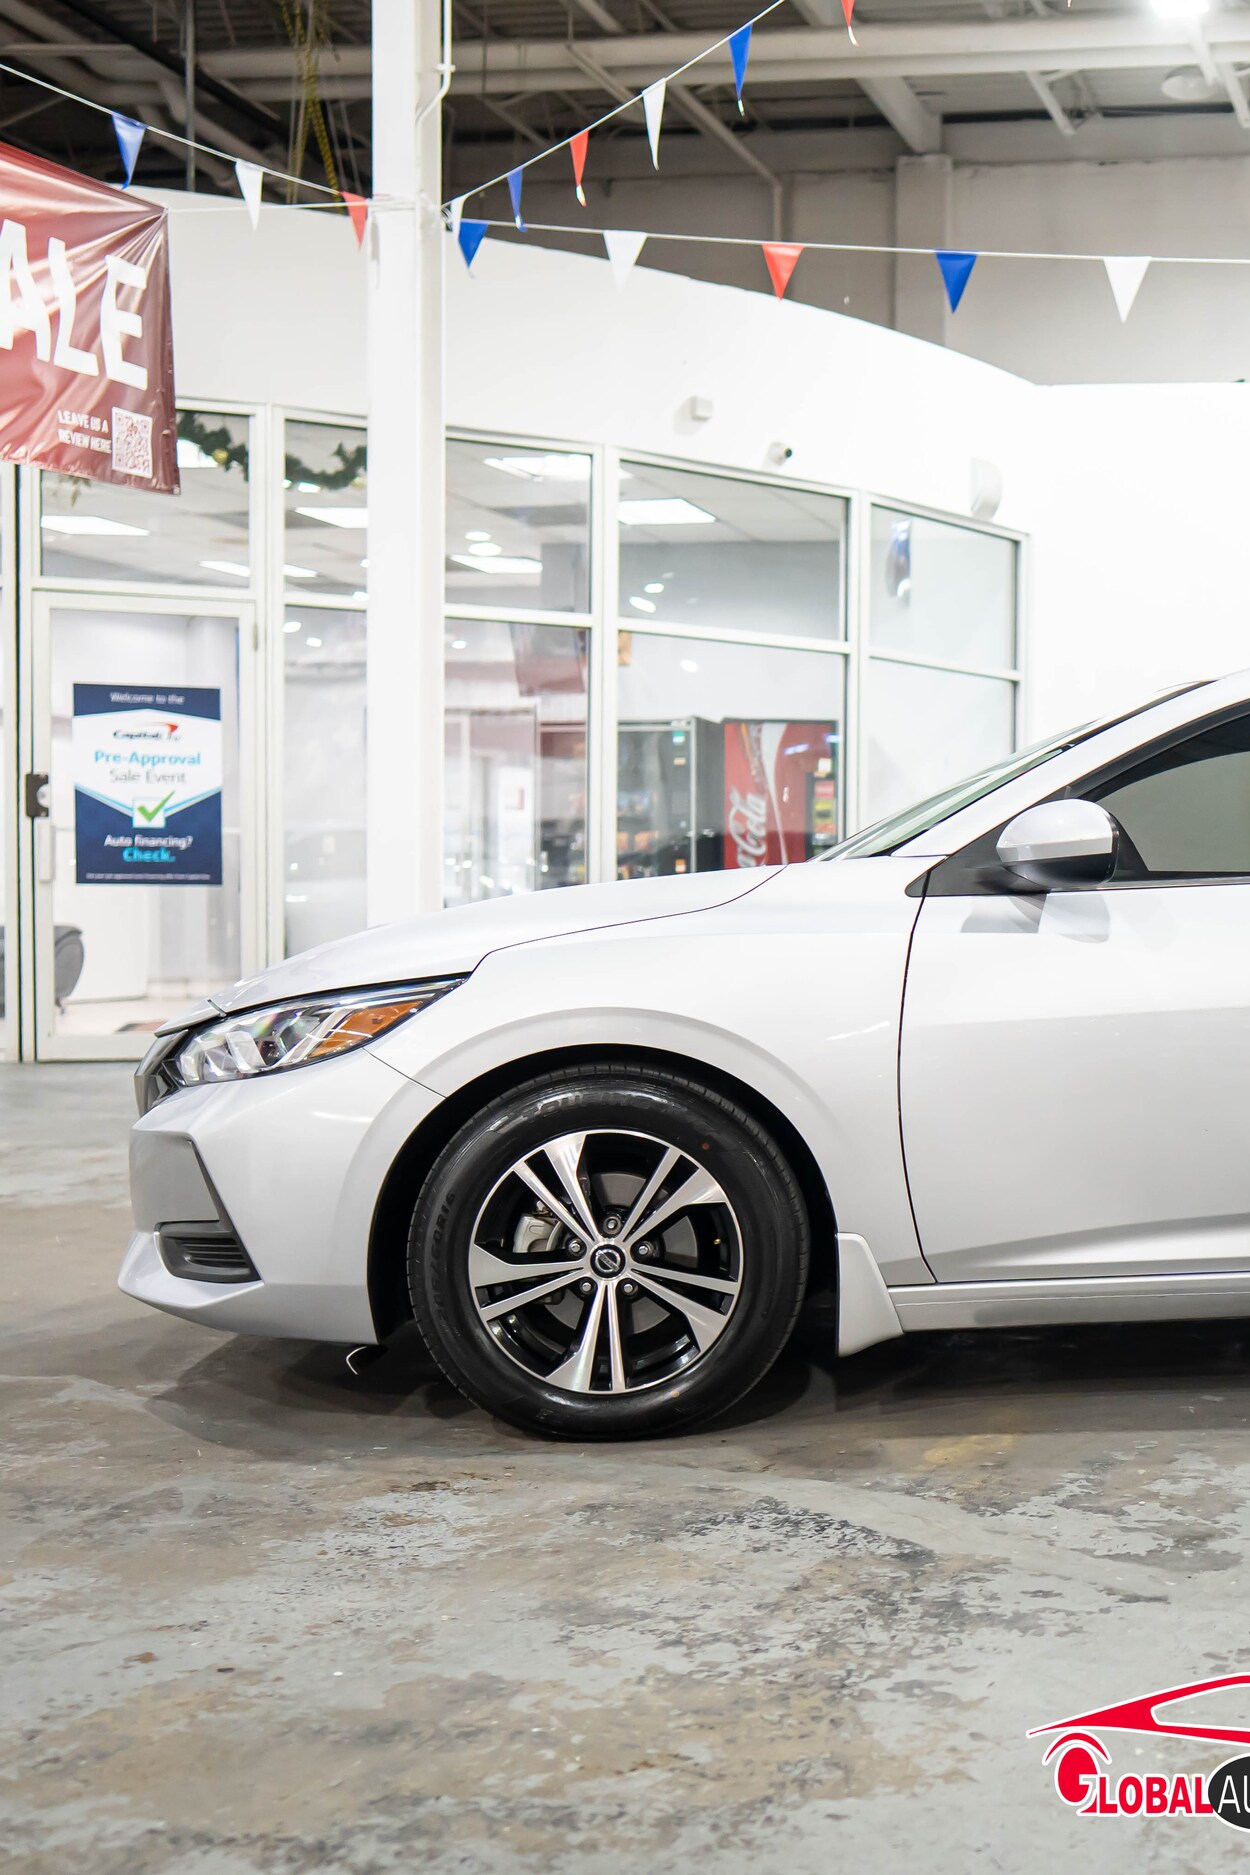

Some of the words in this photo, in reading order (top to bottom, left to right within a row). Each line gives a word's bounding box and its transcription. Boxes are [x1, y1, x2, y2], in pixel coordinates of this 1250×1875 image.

[57, 409, 90, 429] LEAVE
[101, 420, 109, 434] A
[110, 692, 154, 704] Welcome
[156, 694, 166, 705] to
[167, 693, 185, 706] the
[94, 750, 202, 768] Pre-Approval
[110, 769, 141, 783] Sale
[146, 769, 187, 784] Event
[103, 834, 133, 848] Auto
[134, 834, 193, 850] financing?
[122, 847, 176, 862] Check.
